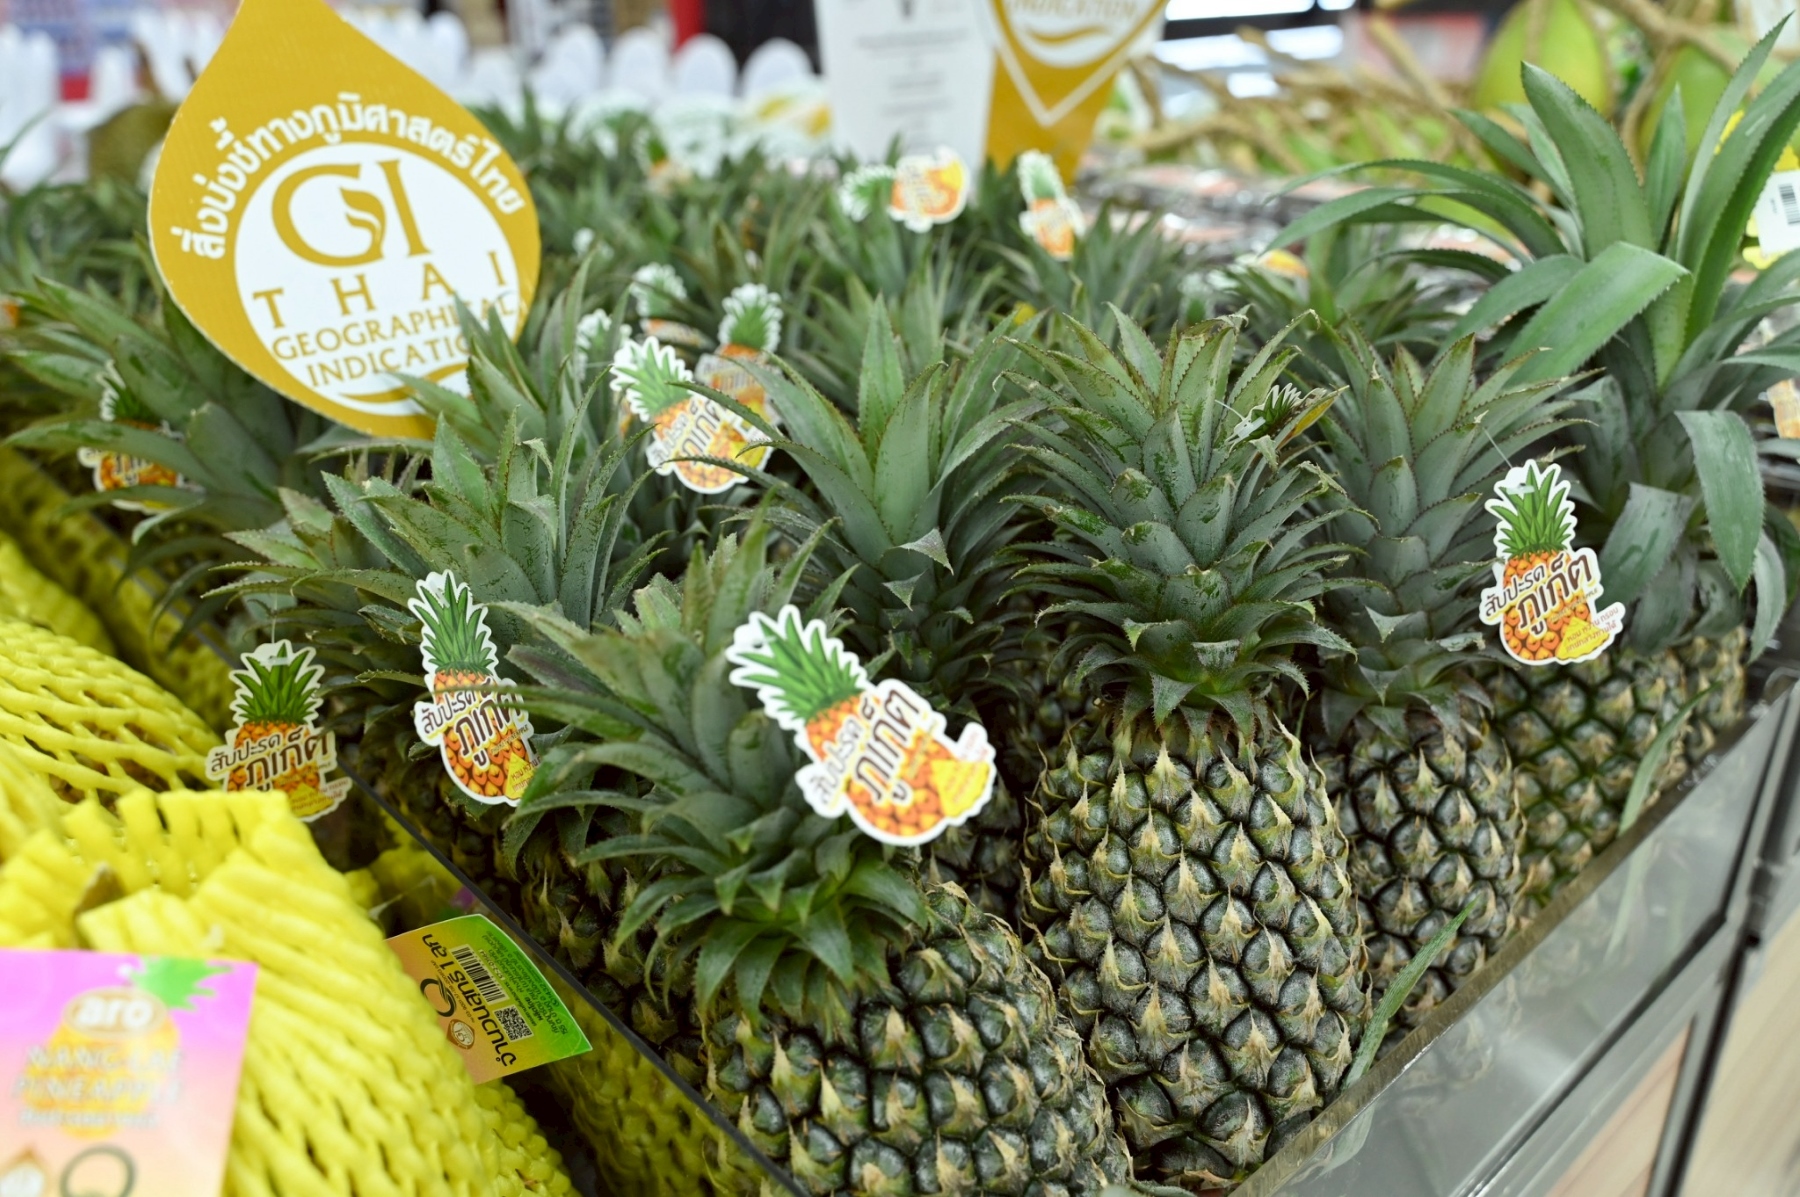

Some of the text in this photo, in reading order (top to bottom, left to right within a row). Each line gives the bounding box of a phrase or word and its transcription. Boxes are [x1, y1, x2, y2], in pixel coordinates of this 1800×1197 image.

[171, 92, 525, 259] สิ่งบ่งชี้ทางภูมิศาสตร์ไทย
[271, 159, 432, 267] GI
[253, 251, 506, 329] THAI
[307, 333, 473, 387] INDICATIO
[1485, 565, 1545, 617] สับปะรด
[1517, 553, 1592, 636] ภูเก็ต
[422, 690, 476, 734] สับปะรด
[855, 689, 920, 801] ภูเก็ต
[211, 735, 281, 772] สับปะรด
[811, 719, 862, 804] สับปะรด
[422, 934, 447, 958] ลูก
[440, 960, 454, 970] 1
[75, 996, 153, 1028] aro
[447, 970, 517, 1067] จำนวนสุทธิ
